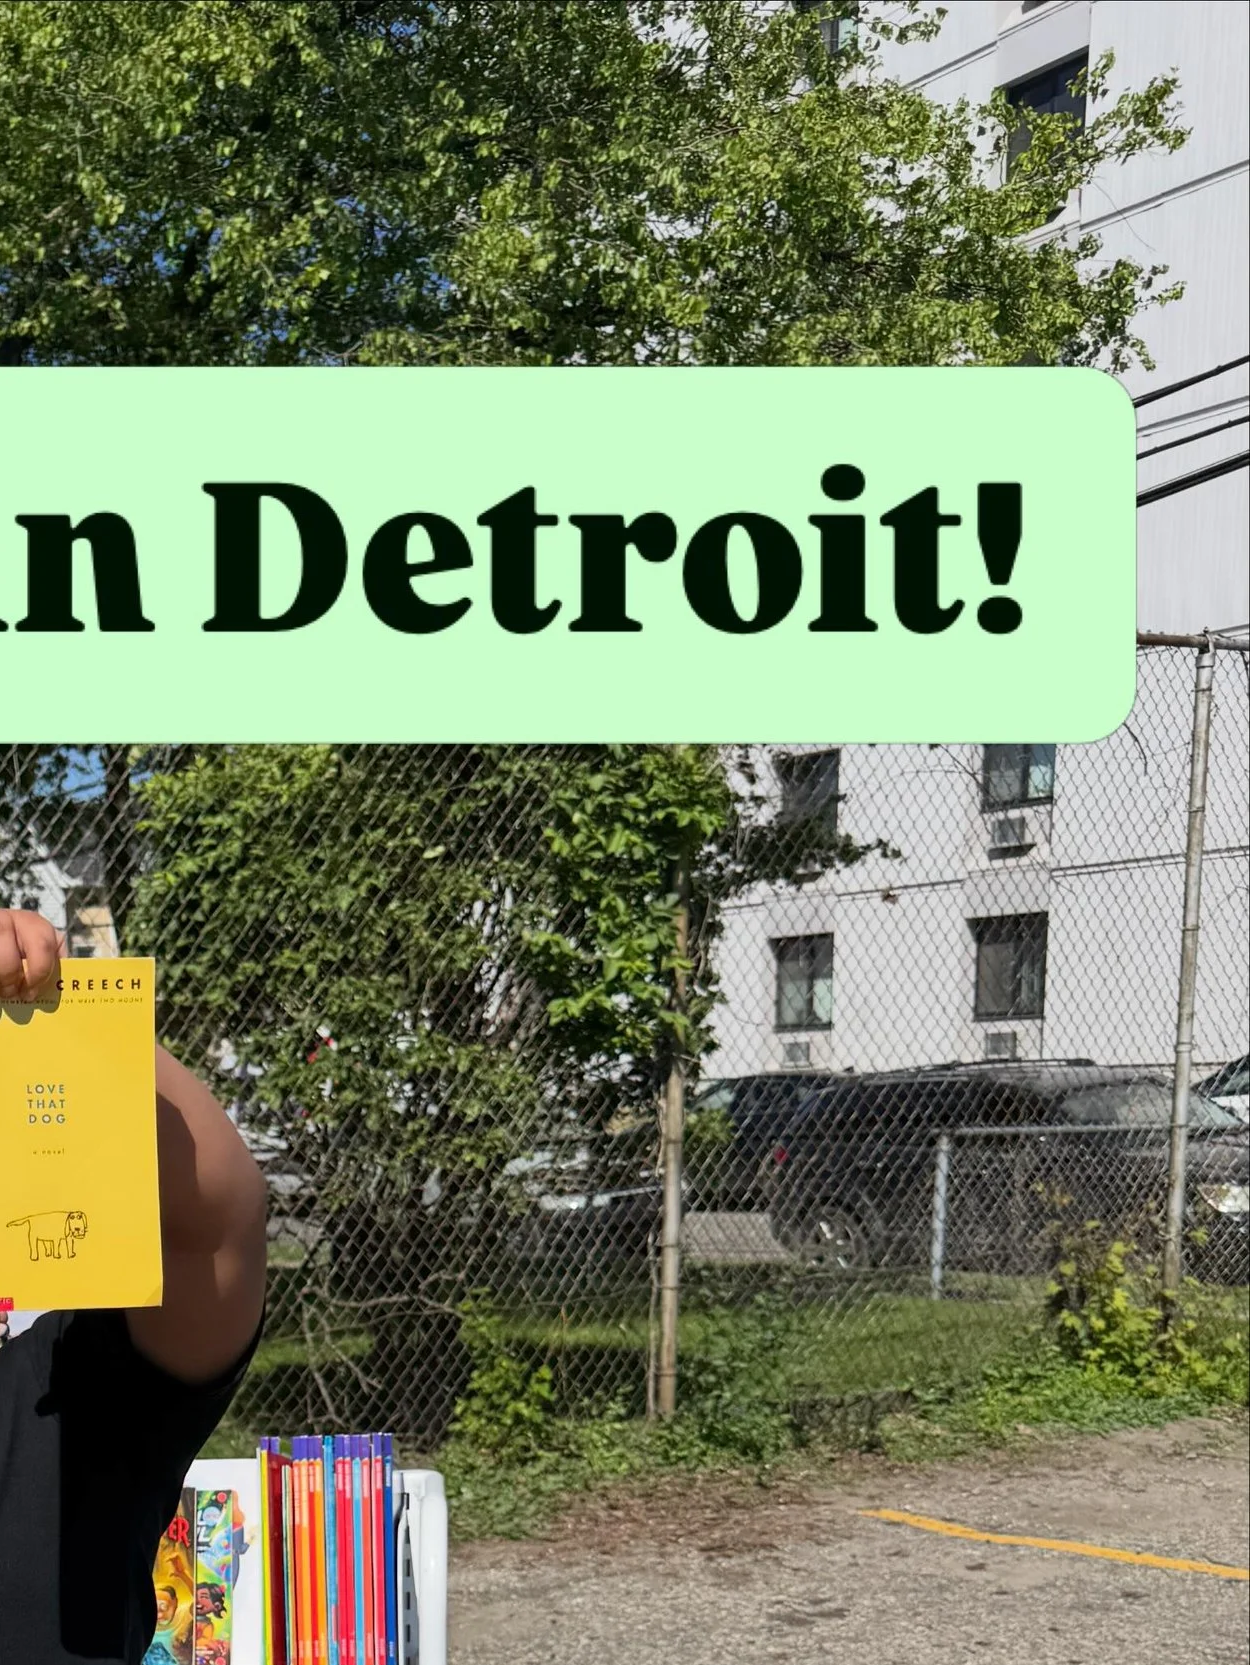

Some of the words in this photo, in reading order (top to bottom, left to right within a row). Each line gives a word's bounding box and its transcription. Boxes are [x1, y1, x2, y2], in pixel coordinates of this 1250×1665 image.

[56, 978, 142, 991] CREECH
[26, 1083, 66, 1095] LOVE
[26, 1098, 67, 1110] THAT
[28, 1113, 67, 1125] DOG
[41, 1147, 66, 1156] novel
